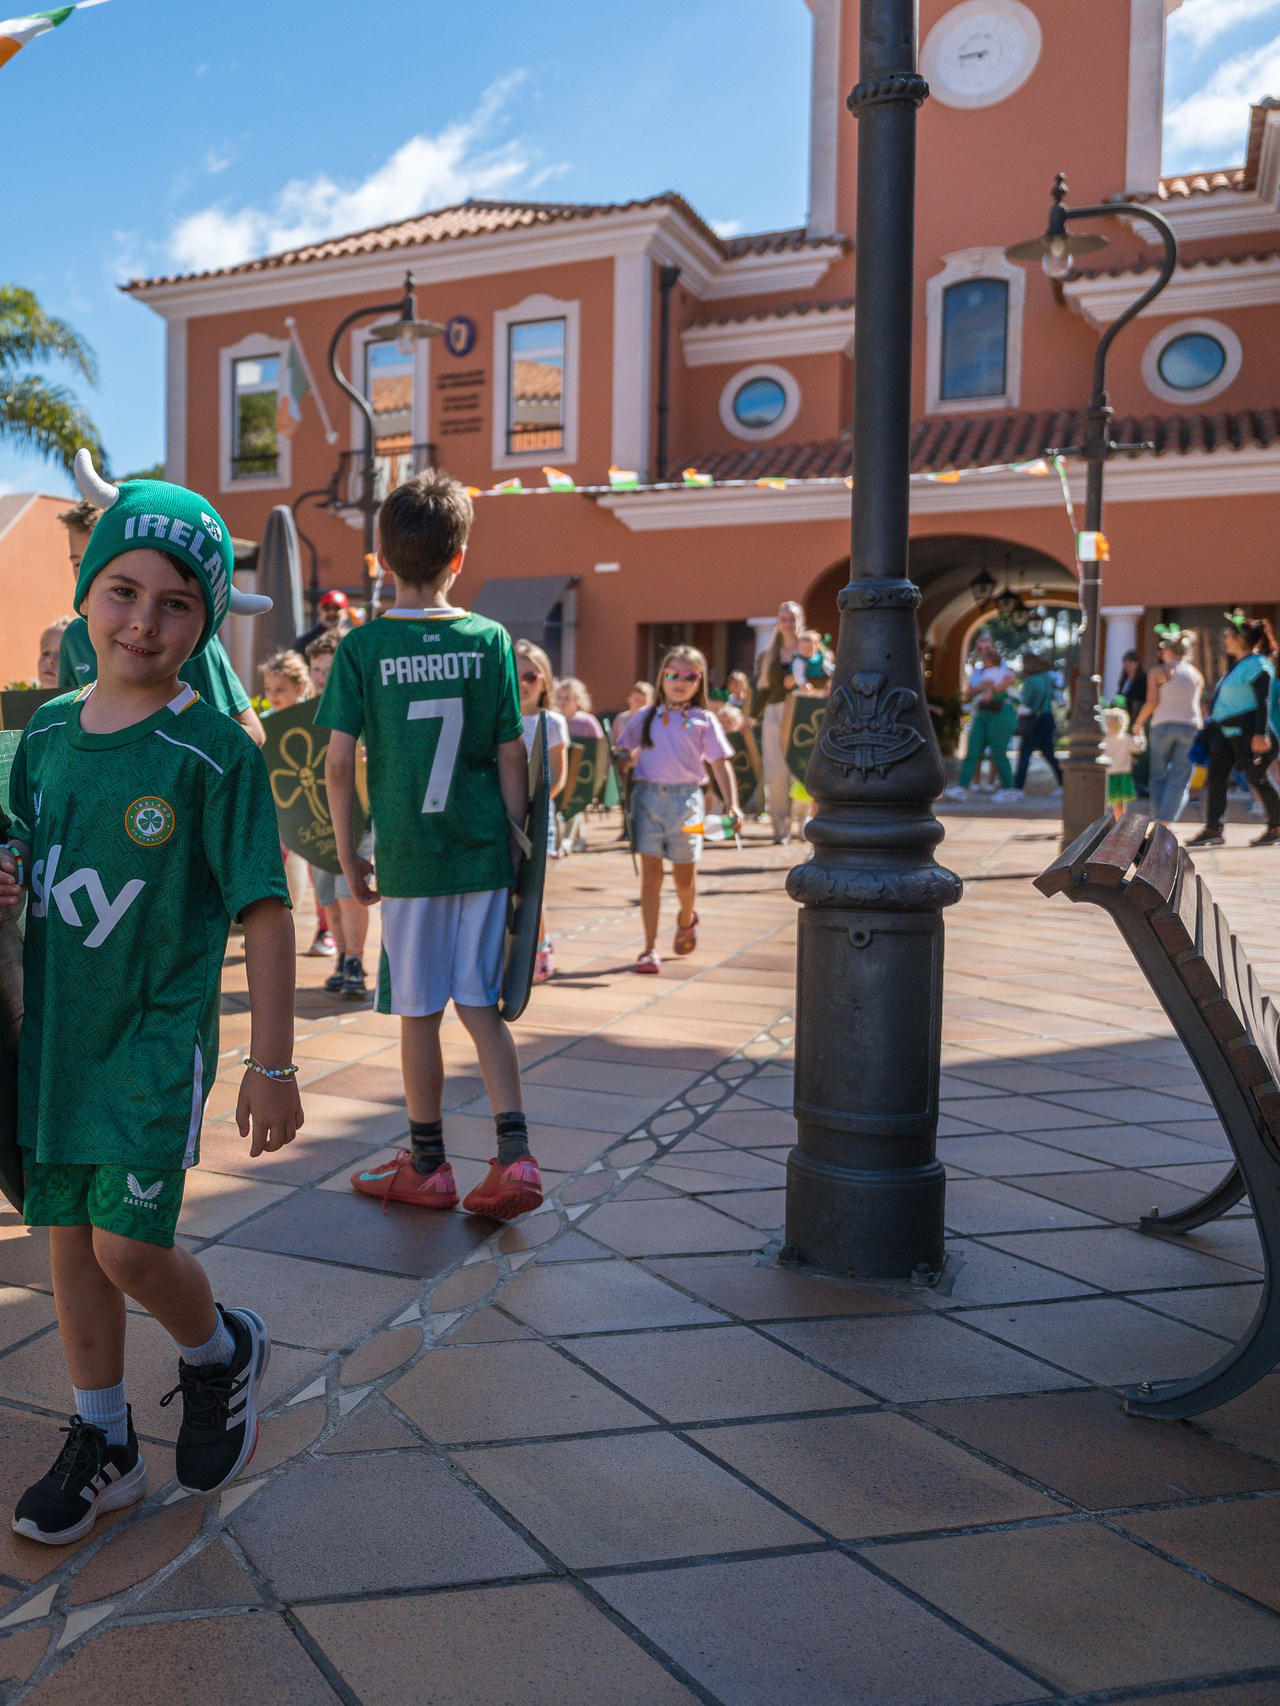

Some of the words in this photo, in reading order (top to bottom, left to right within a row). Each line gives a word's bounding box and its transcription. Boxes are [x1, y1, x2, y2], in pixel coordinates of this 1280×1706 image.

[124, 513, 228, 621] IRELAND
[422, 633, 441, 643] ÉIRE
[379, 652, 485, 687] PARROTT
[406, 697, 464, 814] 7
[134, 801, 171, 817] IRELAND
[31, 844, 147, 949] sky
[123, 1196, 158, 1210] CASTORE
